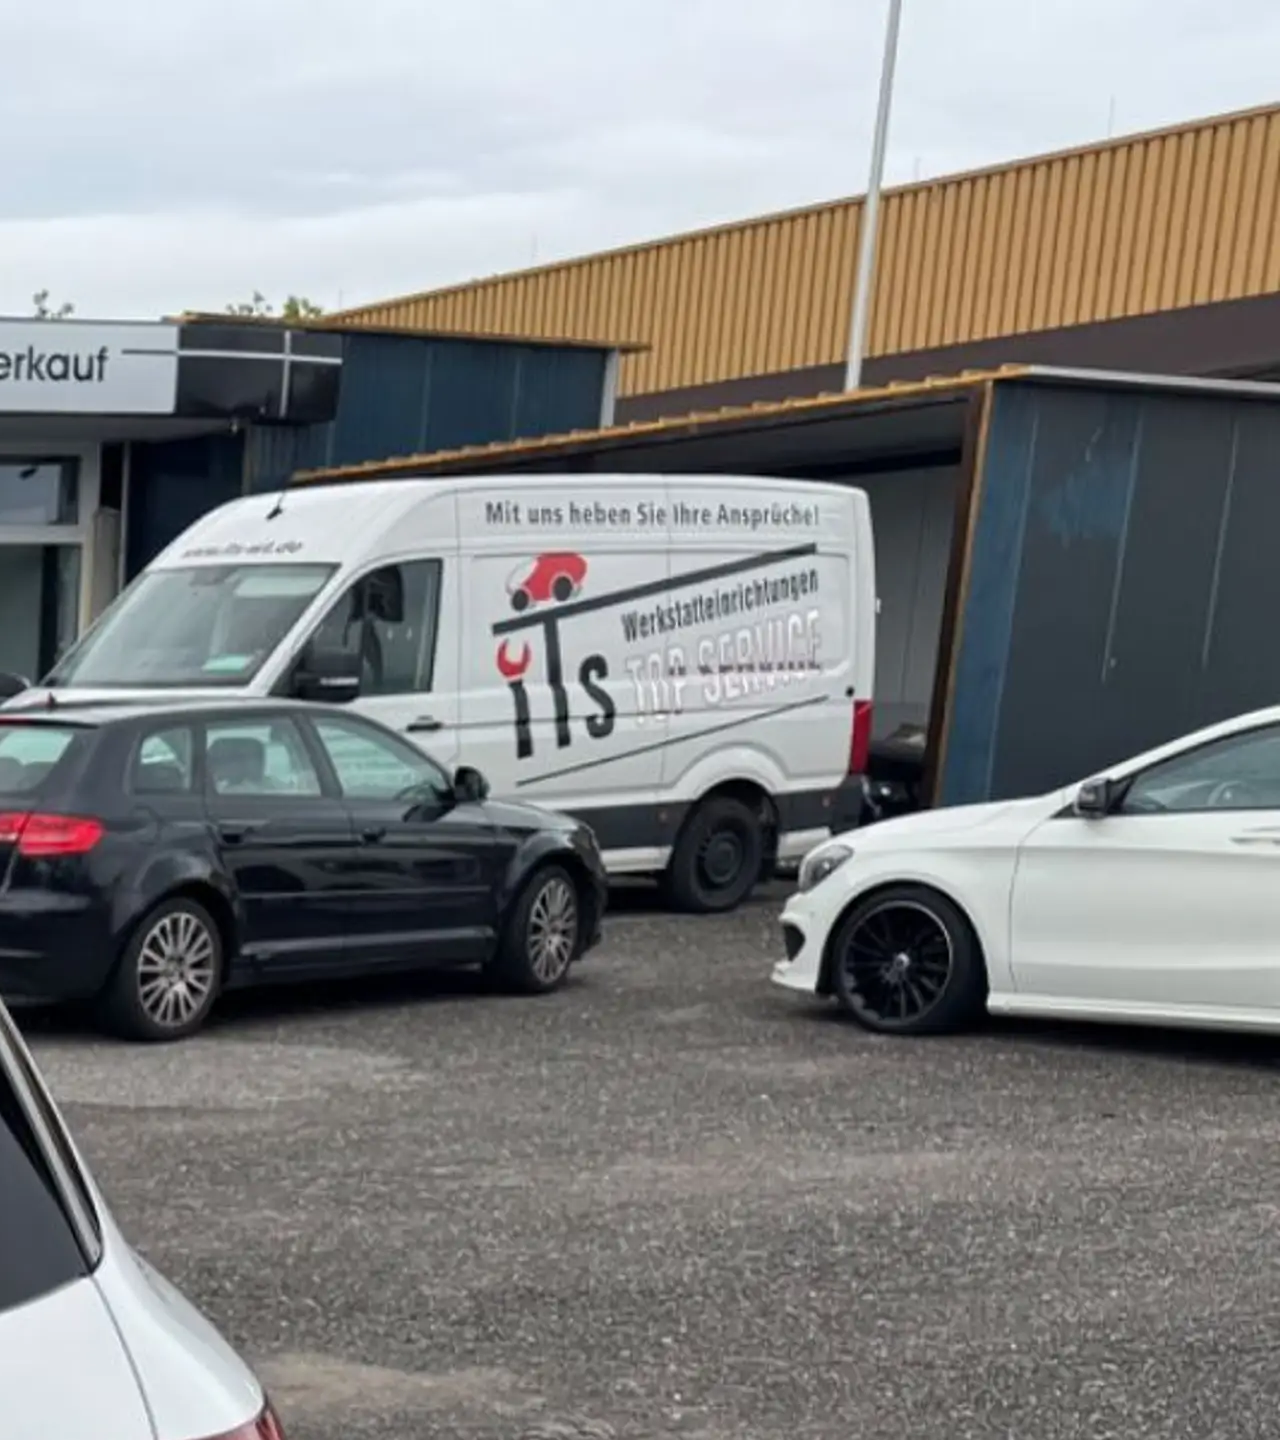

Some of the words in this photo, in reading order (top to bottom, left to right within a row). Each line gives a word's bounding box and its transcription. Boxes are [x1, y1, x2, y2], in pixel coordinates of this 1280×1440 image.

[484, 501, 521, 526] Mit
[527, 505, 564, 525] uns
[569, 502, 631, 526] heben
[637, 502, 667, 526] Sie
[672, 502, 712, 525] Ihre
[716, 502, 820, 531] Ansprüche!
[621, 567, 819, 642] Werkstatteinrichtungen
[624, 644, 688, 724] TOP
[696, 606, 822, 704] SERVICE
